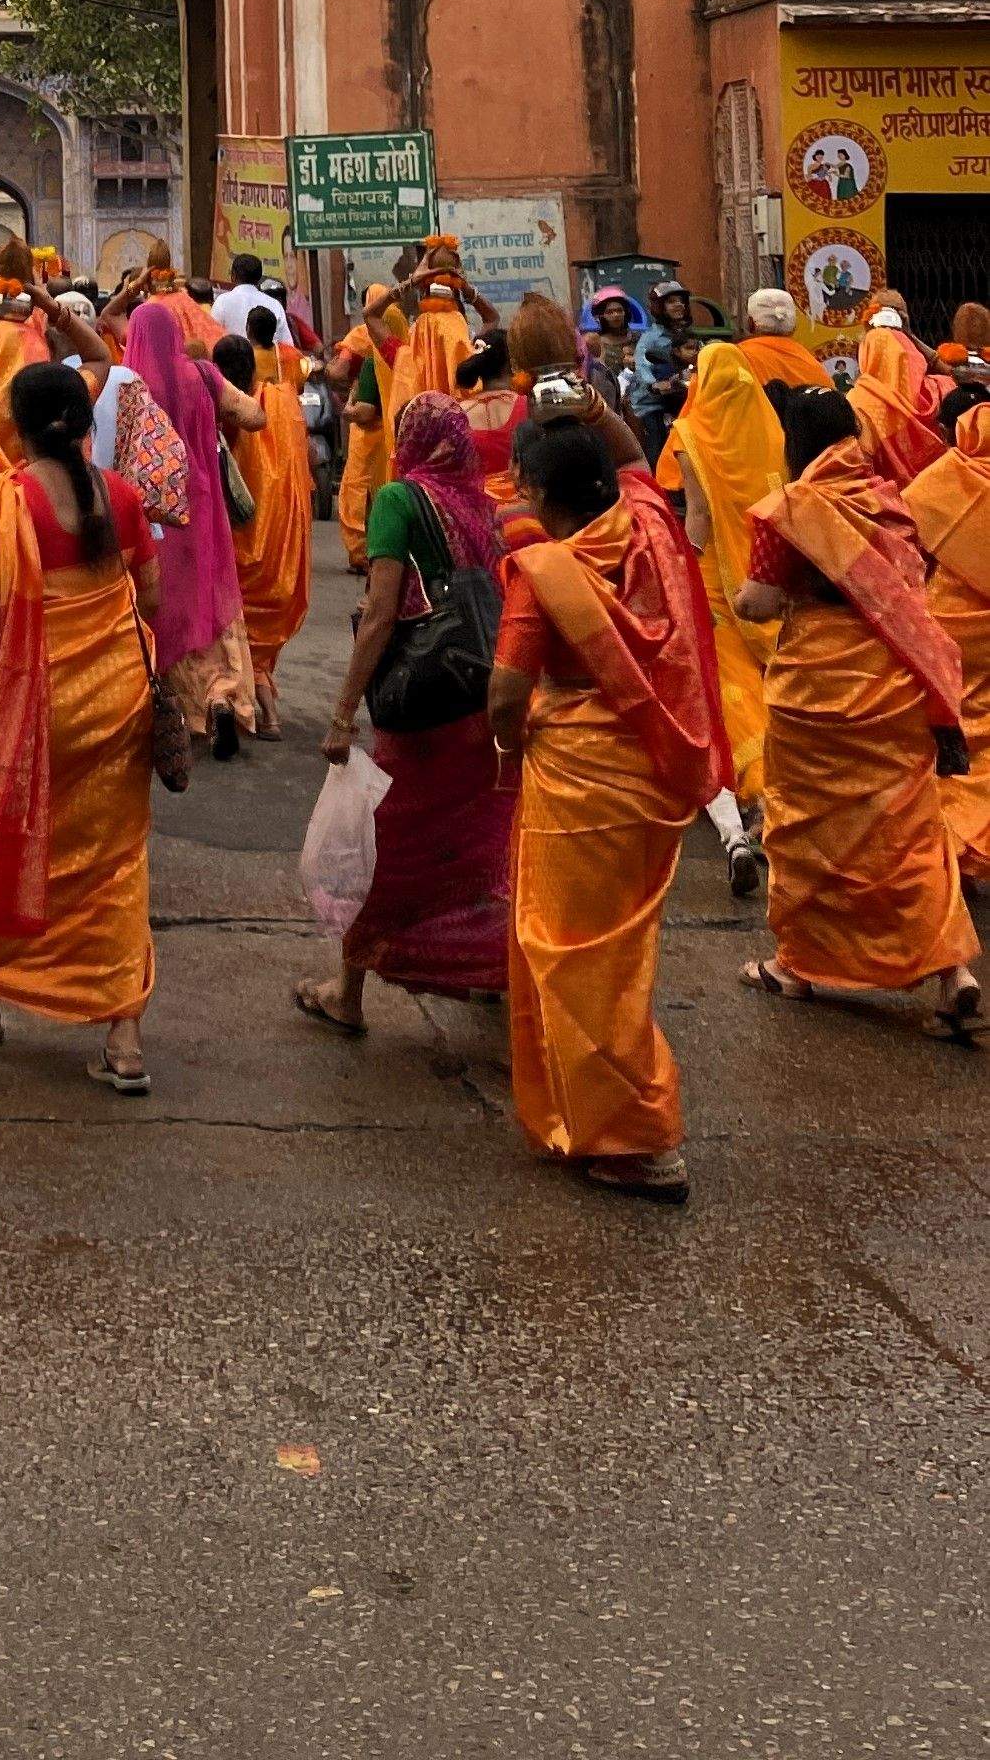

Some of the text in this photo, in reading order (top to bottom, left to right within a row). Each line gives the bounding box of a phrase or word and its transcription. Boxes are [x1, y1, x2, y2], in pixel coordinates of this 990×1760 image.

[792, 66, 902, 108] आयुष्मान
[903, 65, 960, 98] भारत
[880, 105, 925, 144] शहरी
[298, 143, 325, 186] डॉ.
[327, 142, 371, 184] महेश
[373, 140, 421, 182] जोशी
[948, 155, 990, 177] जय
[331, 187, 392, 207] विधायक
